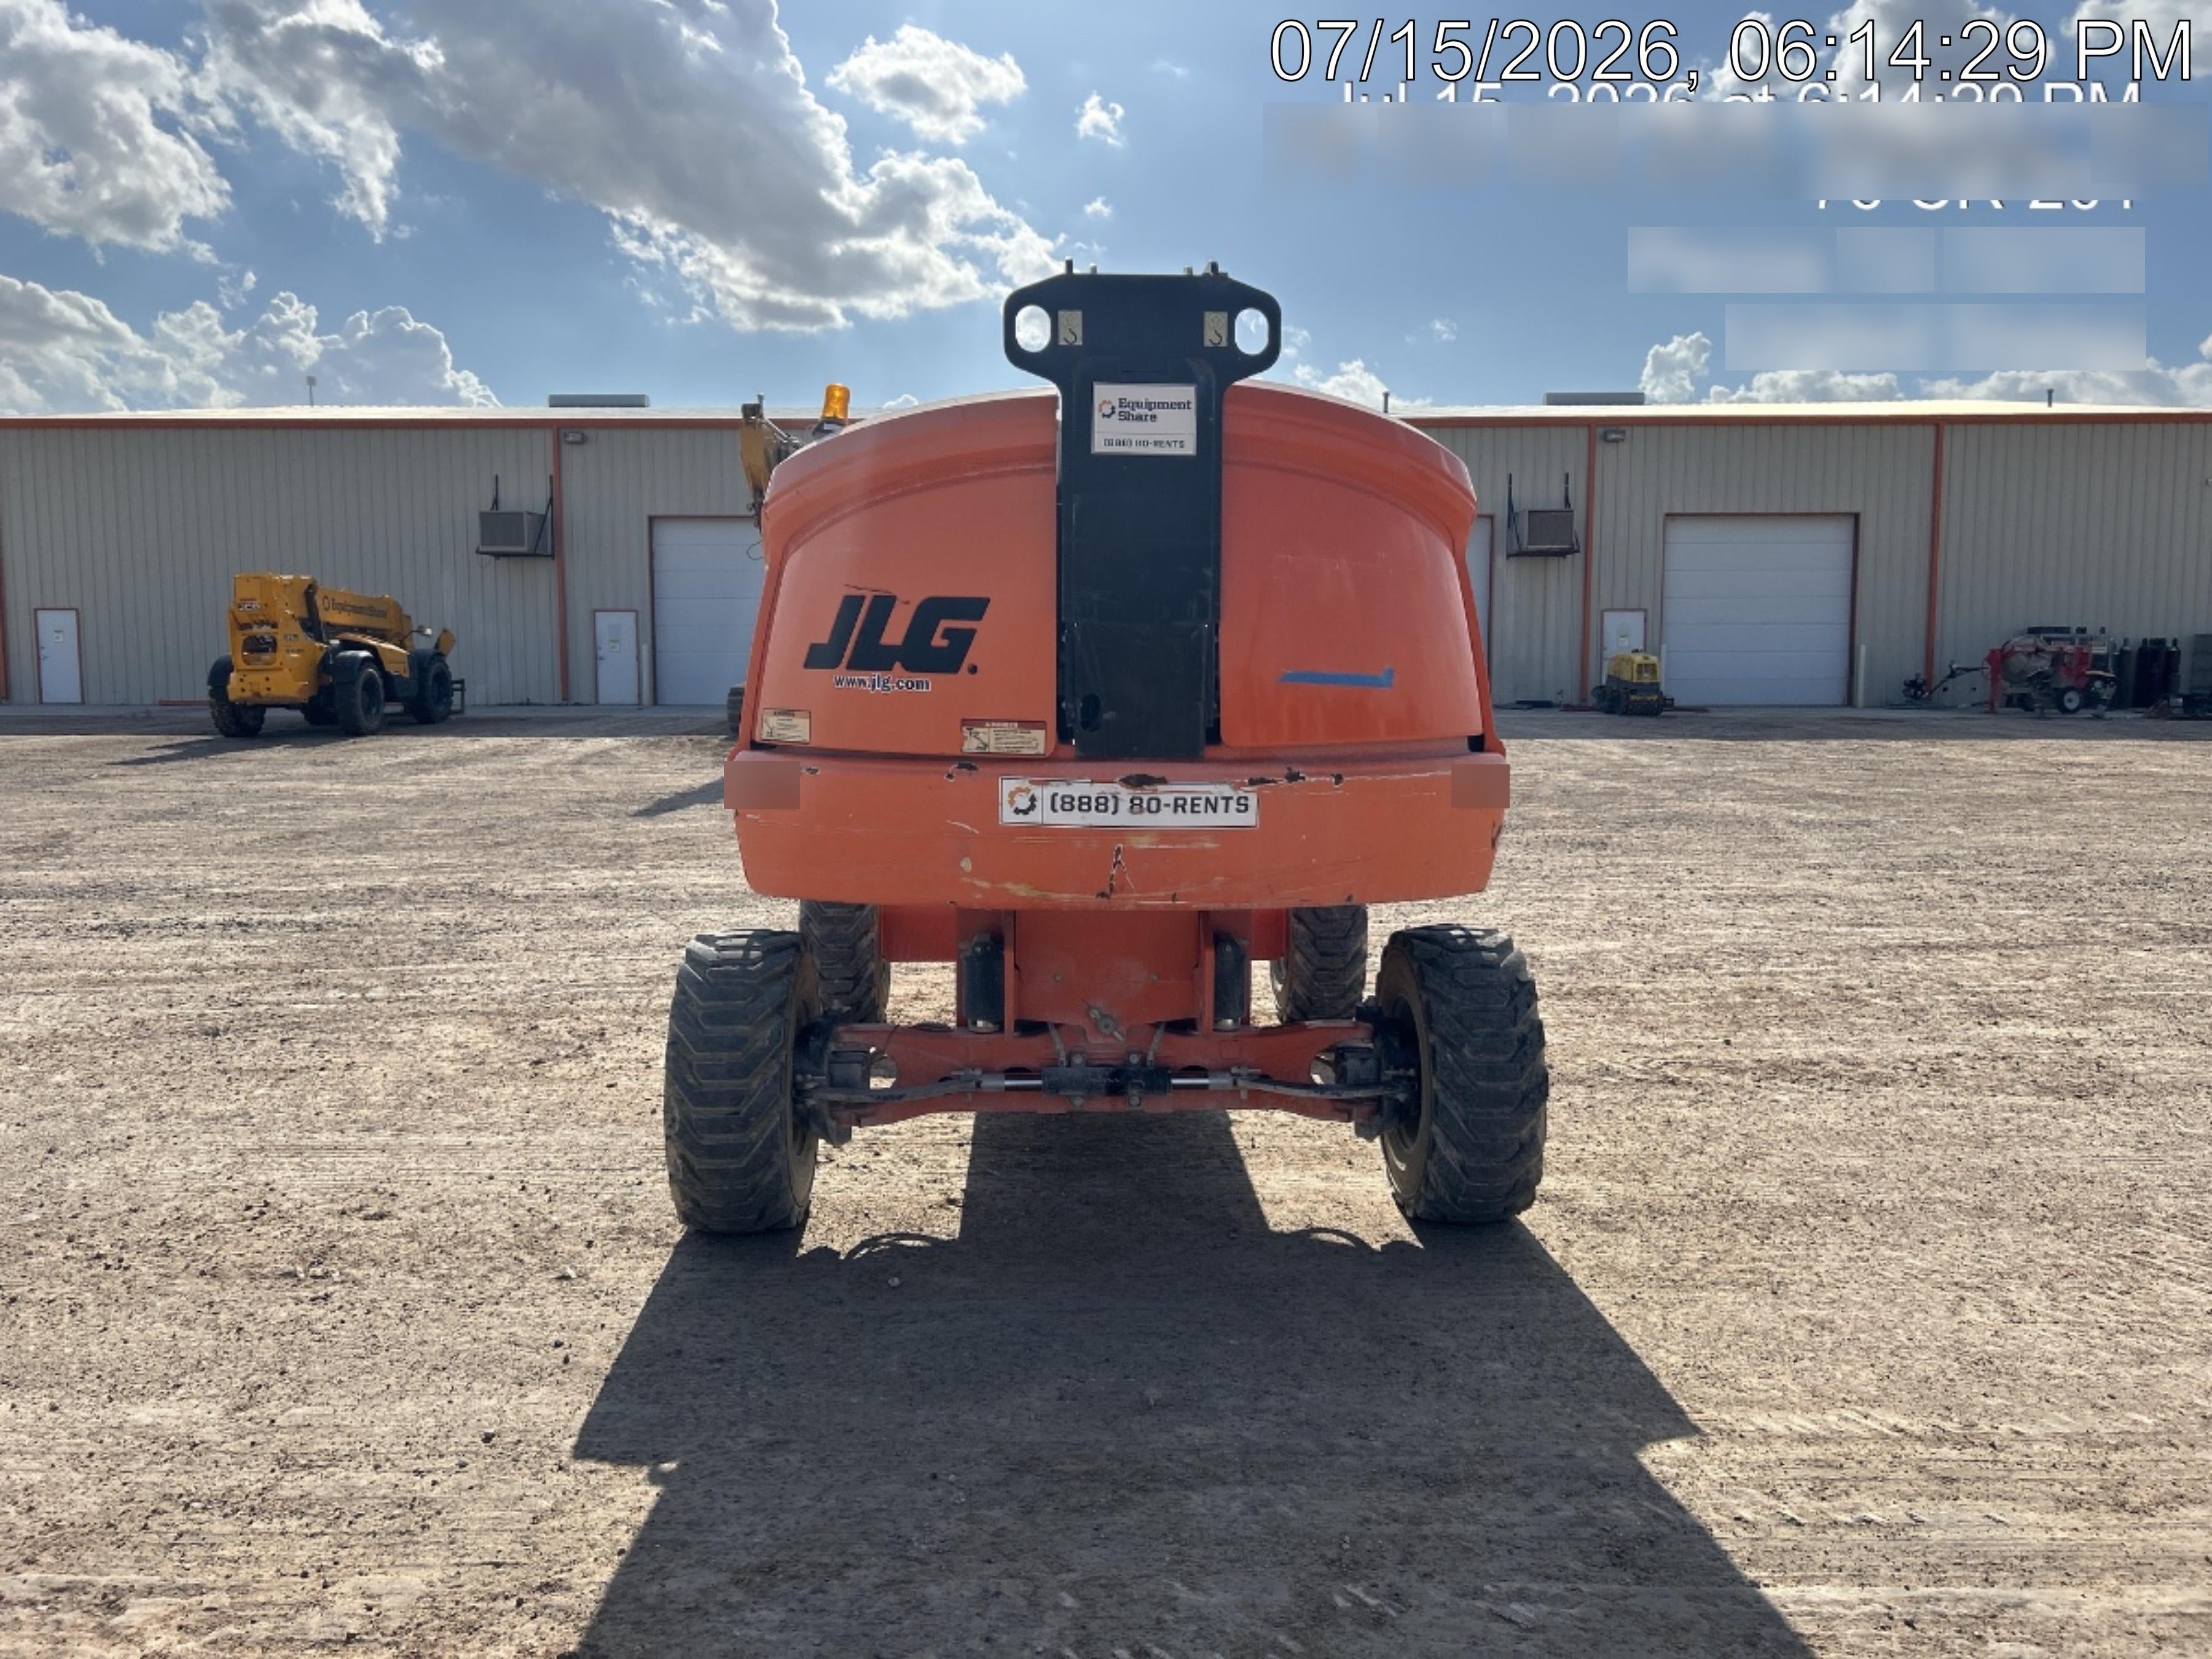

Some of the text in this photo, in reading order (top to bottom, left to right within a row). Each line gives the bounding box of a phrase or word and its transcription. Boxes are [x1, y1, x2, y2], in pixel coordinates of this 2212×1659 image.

[1118, 398, 1192, 412] Equipment
[1118, 410, 1158, 423] Share
[834, 673, 930, 693] www.jlg.com
[1050, 791, 1249, 815] (888) 80-RENTS
